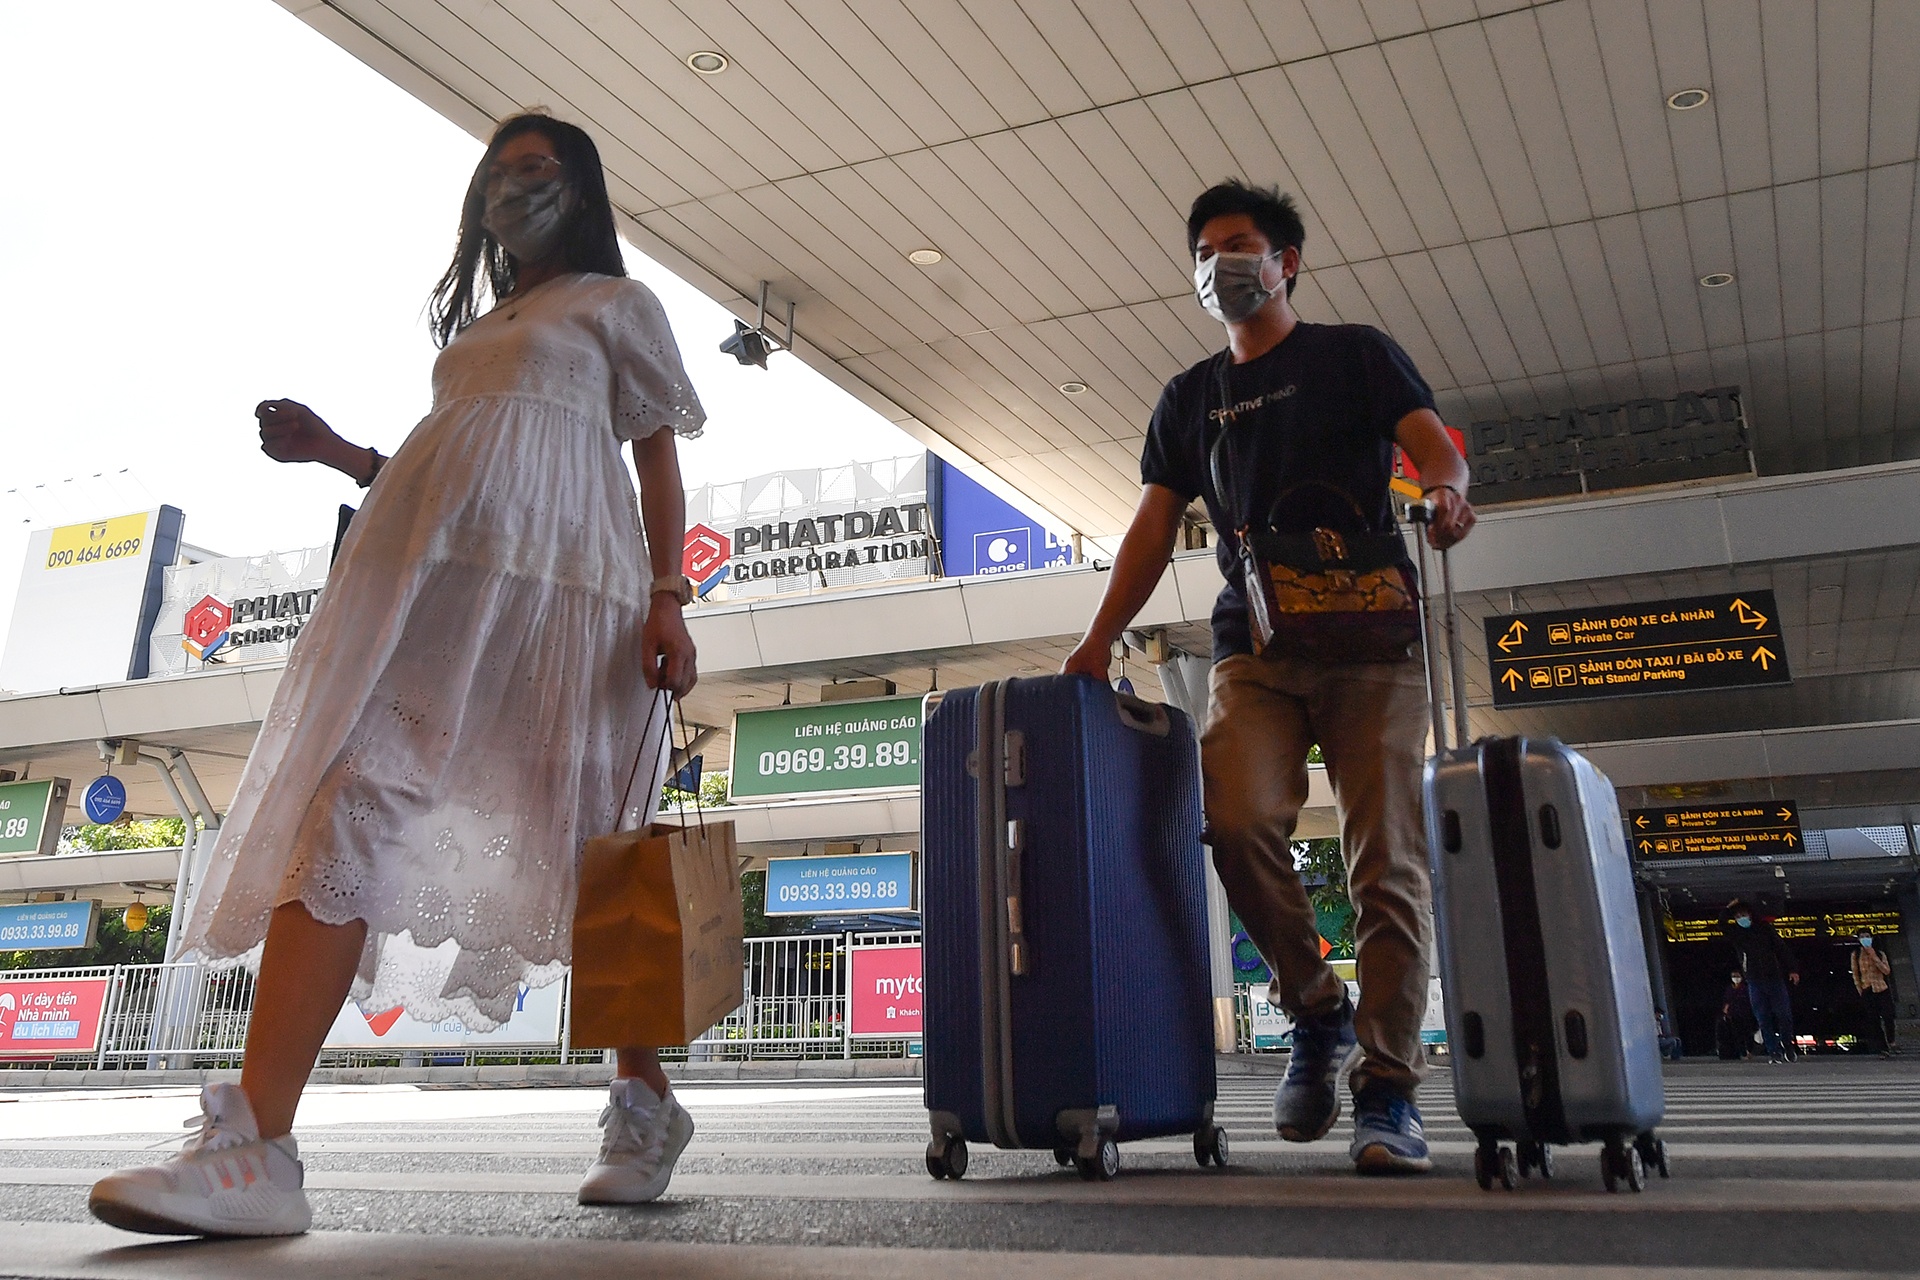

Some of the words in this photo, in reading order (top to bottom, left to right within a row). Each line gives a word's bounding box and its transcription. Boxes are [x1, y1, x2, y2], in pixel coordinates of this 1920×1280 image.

[1472, 385, 1740, 455] PHATDAT
[734, 503, 927, 556] PHATDAT
[48, 549, 74, 567] 090
[77, 545, 102, 562] 464
[106, 538, 140, 558] 6699
[734, 539, 928, 580] CORPORATION
[980, 562, 1026, 575] nanoe
[232, 588, 323, 624] PHAT
[1573, 618, 1607, 632] SẢNH
[1611, 615, 1638, 629] ĐÓN
[1641, 614, 1658, 626] XE
[1661, 611, 1678, 624] CÁ
[1681, 609, 1715, 622] NHÂN
[1574, 631, 1612, 644] Private
[1615, 630, 1635, 641] Car
[1579, 659, 1613, 674] SẢNH
[1616, 657, 1642, 671] ĐÓN
[1645, 655, 1673, 668] TAXI
[1684, 651, 1704, 664] BÃI
[1727, 650, 1743, 661] XE
[1580, 675, 1603, 686] Taxi
[1606, 672, 1641, 684] Stand/
[1643, 669, 1685, 681] Parking
[795, 724, 822, 738] LIÊN
[825, 723, 842, 737] HỆ
[845, 718, 887, 734] QUẢNG
[890, 715, 916, 730] CÁO
[758, 740, 920, 776] 0969.39.89.
[1720, 810, 1730, 818] XE
[0, 817, 29, 838] .89
[1682, 820, 1704, 828] Private
[1723, 835, 1740, 843] TAXI
[1770, 833, 1780, 841] XE
[801, 869, 817, 878] LIÊN
[860, 866, 877, 876] CÁO
[779, 880, 898, 902] 0933.33.99.88
[1, 923, 79, 940] 0933.33.99.88
[21, 992, 34, 1006] Ví
[34, 992, 55, 1008] dày
[56, 990, 77, 1005] tiền
[18, 1008, 39, 1021] Nhà
[41, 1007, 70, 1021] mình
[899, 1008, 920, 1016] Khách
[14, 1023, 29, 1037] du
[30, 1023, 50, 1039] lịch
